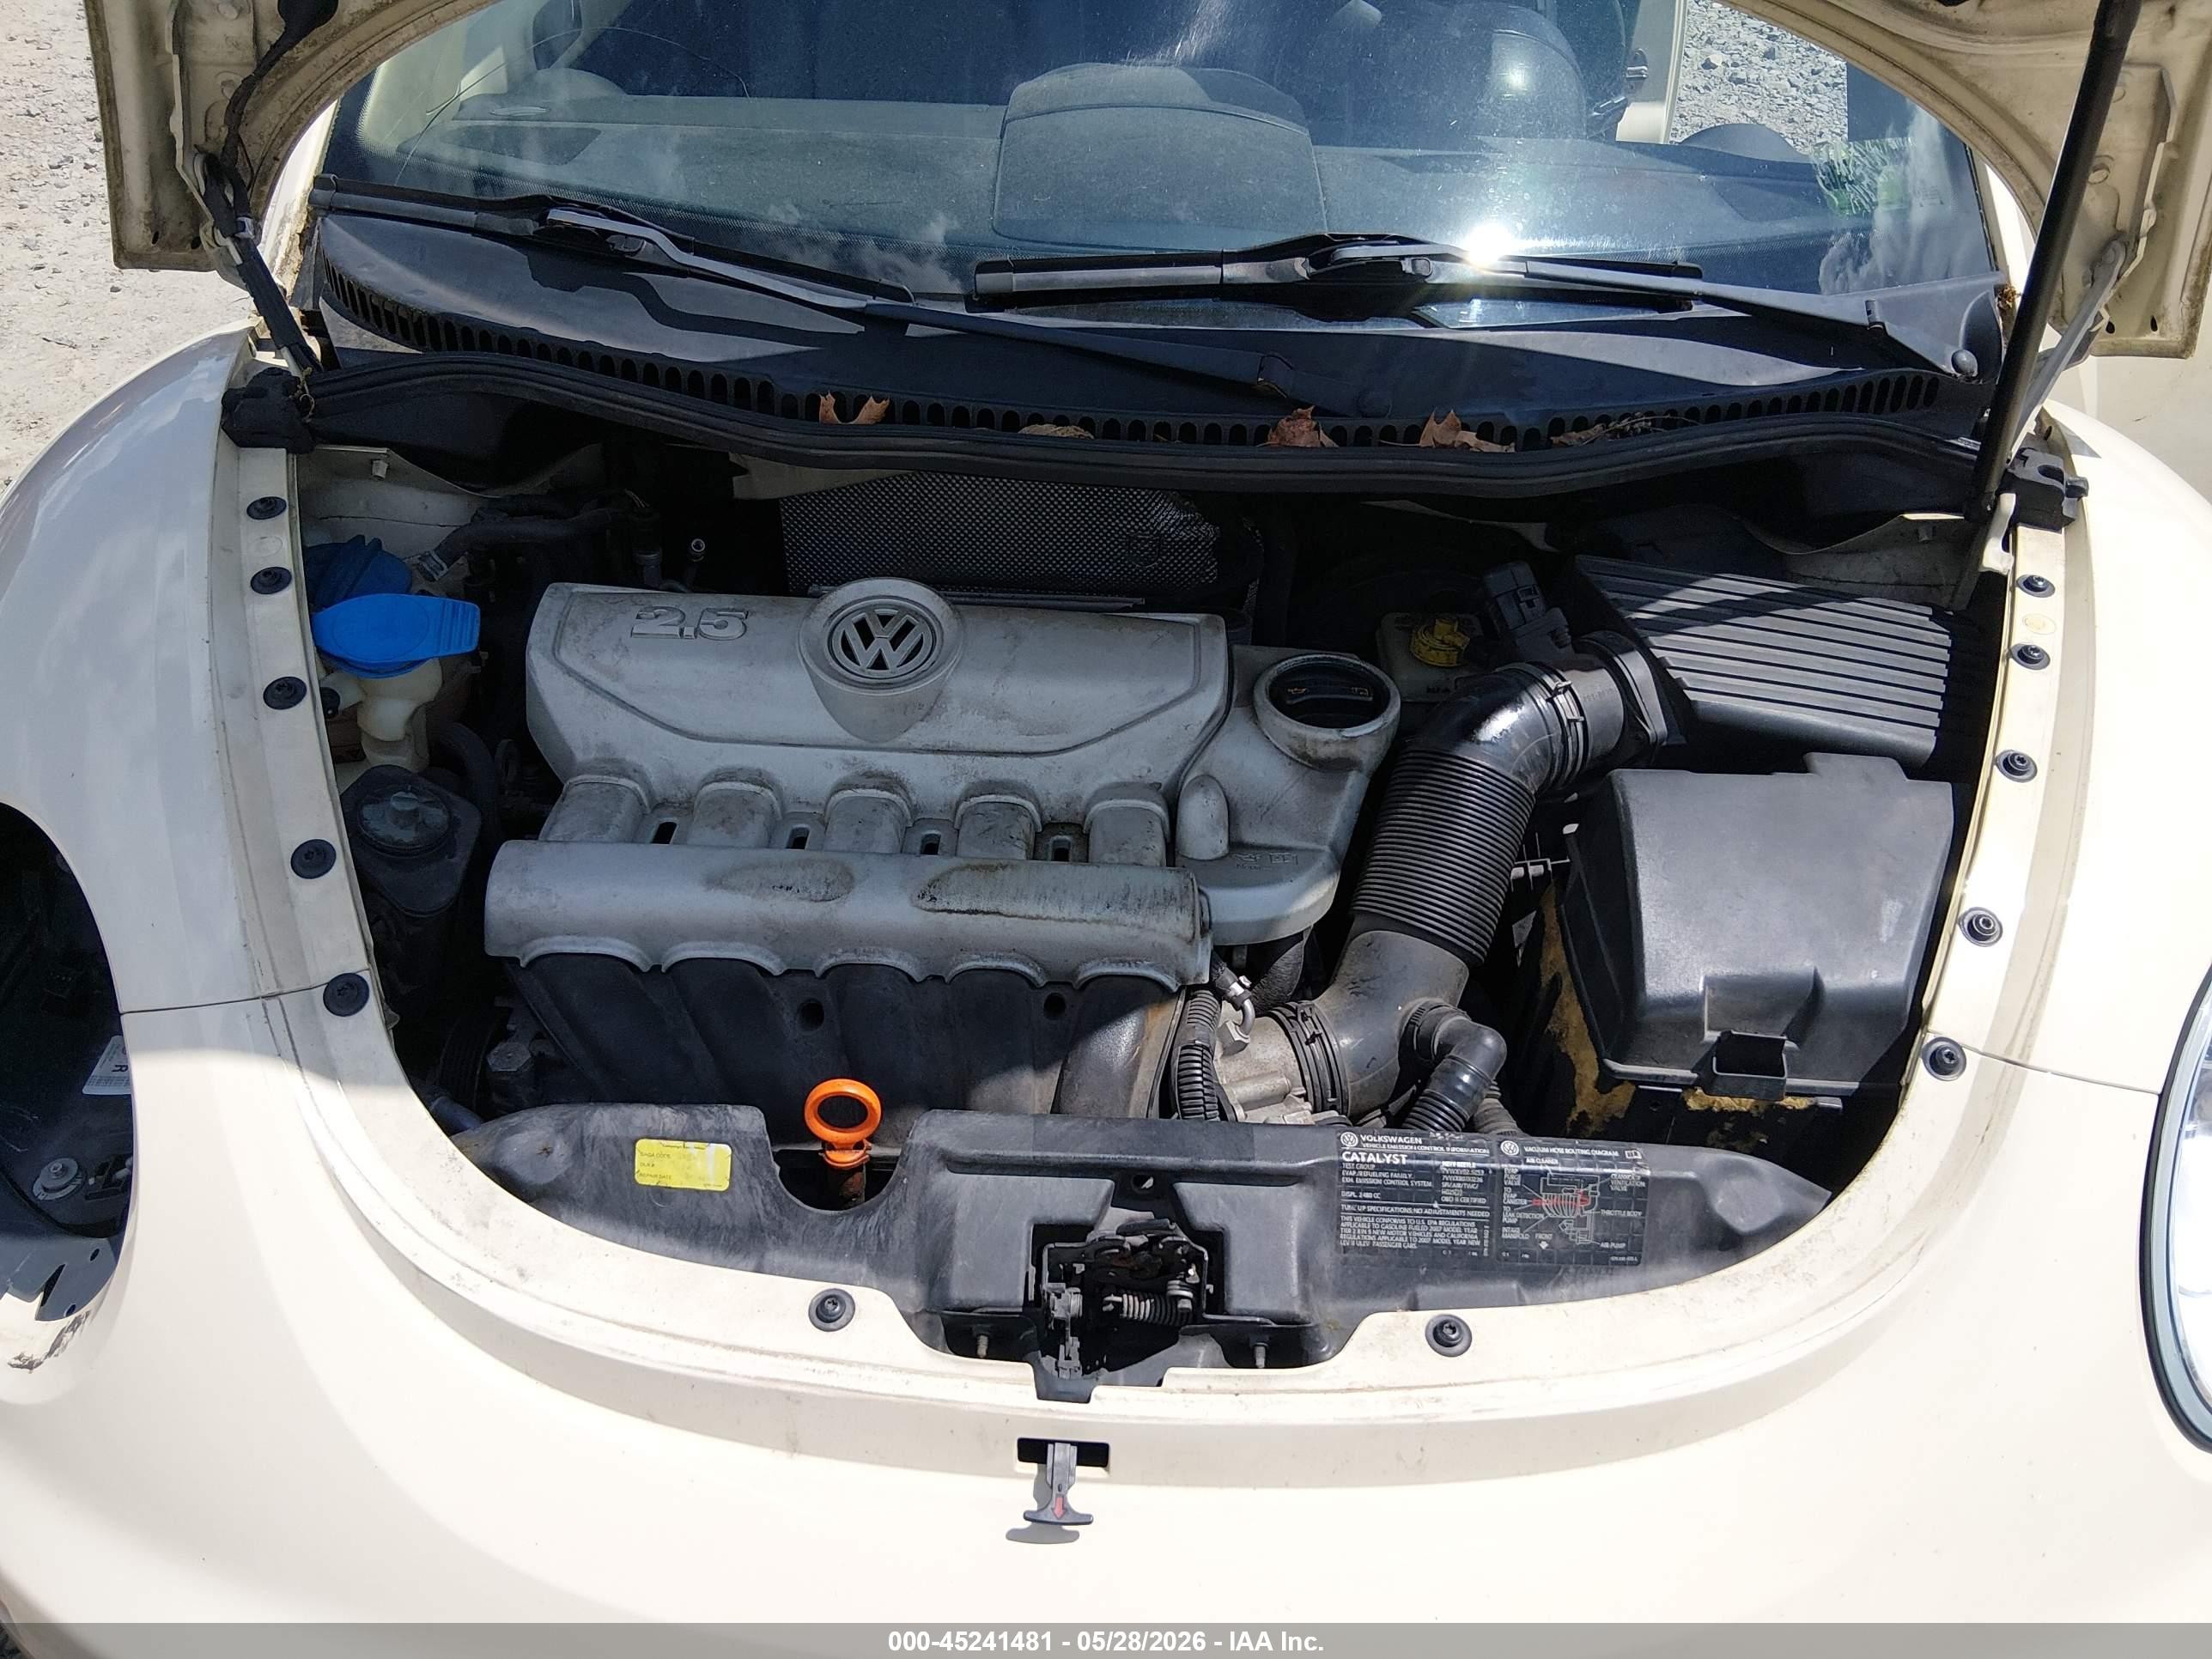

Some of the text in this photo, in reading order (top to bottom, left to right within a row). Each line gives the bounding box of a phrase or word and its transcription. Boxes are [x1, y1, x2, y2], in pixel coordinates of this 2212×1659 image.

[631, 606, 748, 641] 2.5
[1360, 1134, 1422, 1144] VOLKSWAGEN
[1341, 1151, 1408, 1164] CATALYST
